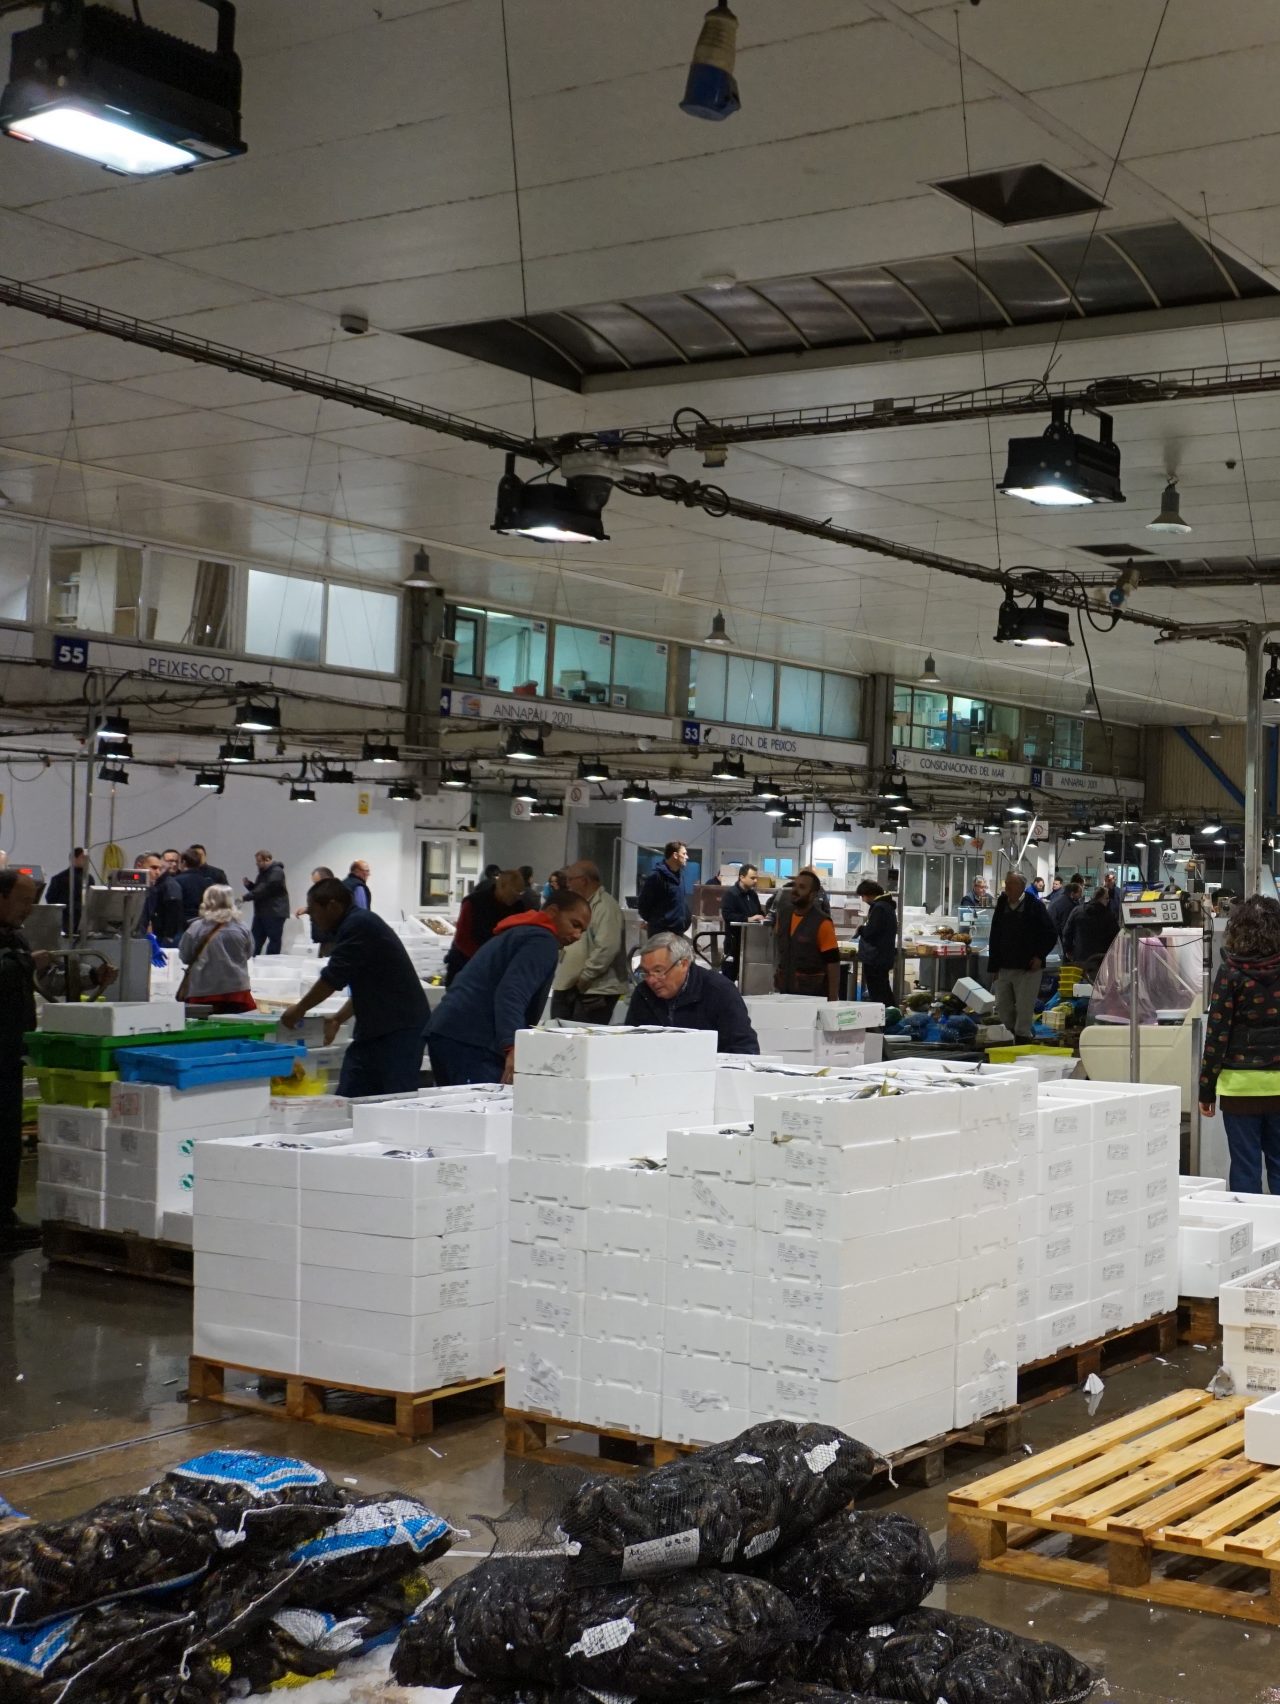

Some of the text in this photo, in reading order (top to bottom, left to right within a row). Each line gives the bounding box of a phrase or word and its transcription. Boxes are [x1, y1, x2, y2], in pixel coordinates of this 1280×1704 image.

[58, 645, 85, 664] 55
[148, 657, 234, 682] PEIXESCOT
[493, 703, 574, 726] ANNAPAU 2001
[684, 727, 698, 740] 53
[757, 737, 768, 749] DE
[771, 739, 797, 753] PEIXOS
[919, 757, 978, 776] CONSIGNACIONES
[980, 767, 990, 777] DEL
